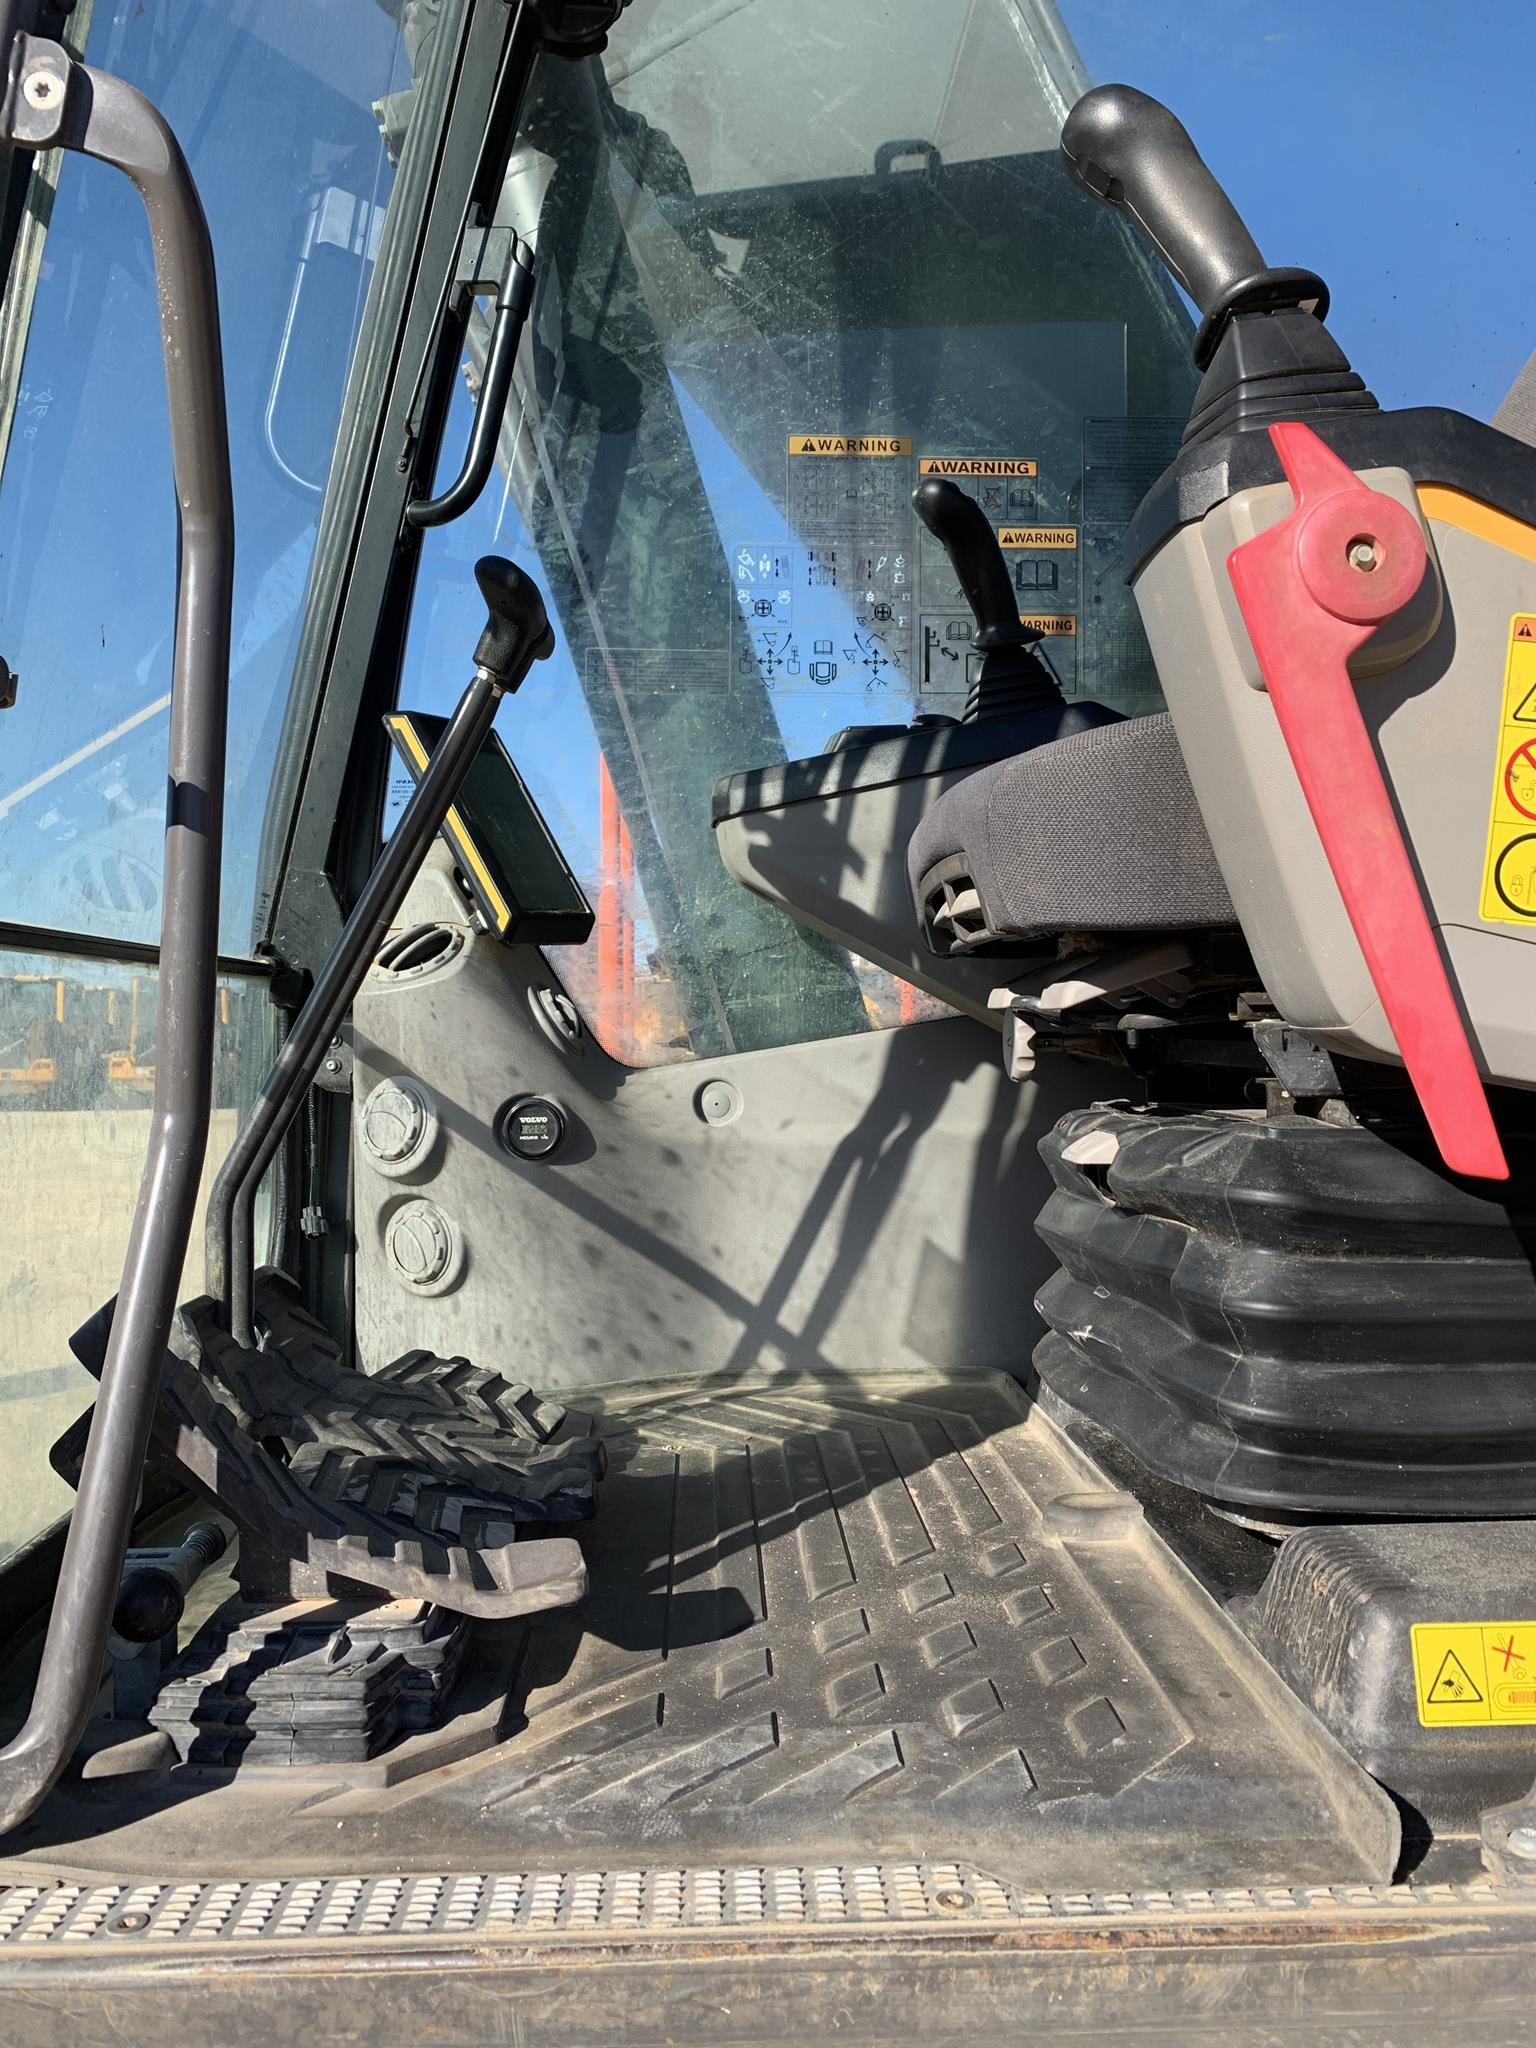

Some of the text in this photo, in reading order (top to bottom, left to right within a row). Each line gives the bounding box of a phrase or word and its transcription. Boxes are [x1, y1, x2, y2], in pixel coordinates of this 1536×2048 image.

[817, 439, 901, 452] WARNING
[940, 461, 1029, 474] WARNING
[1014, 532, 1075, 544] WARNING
